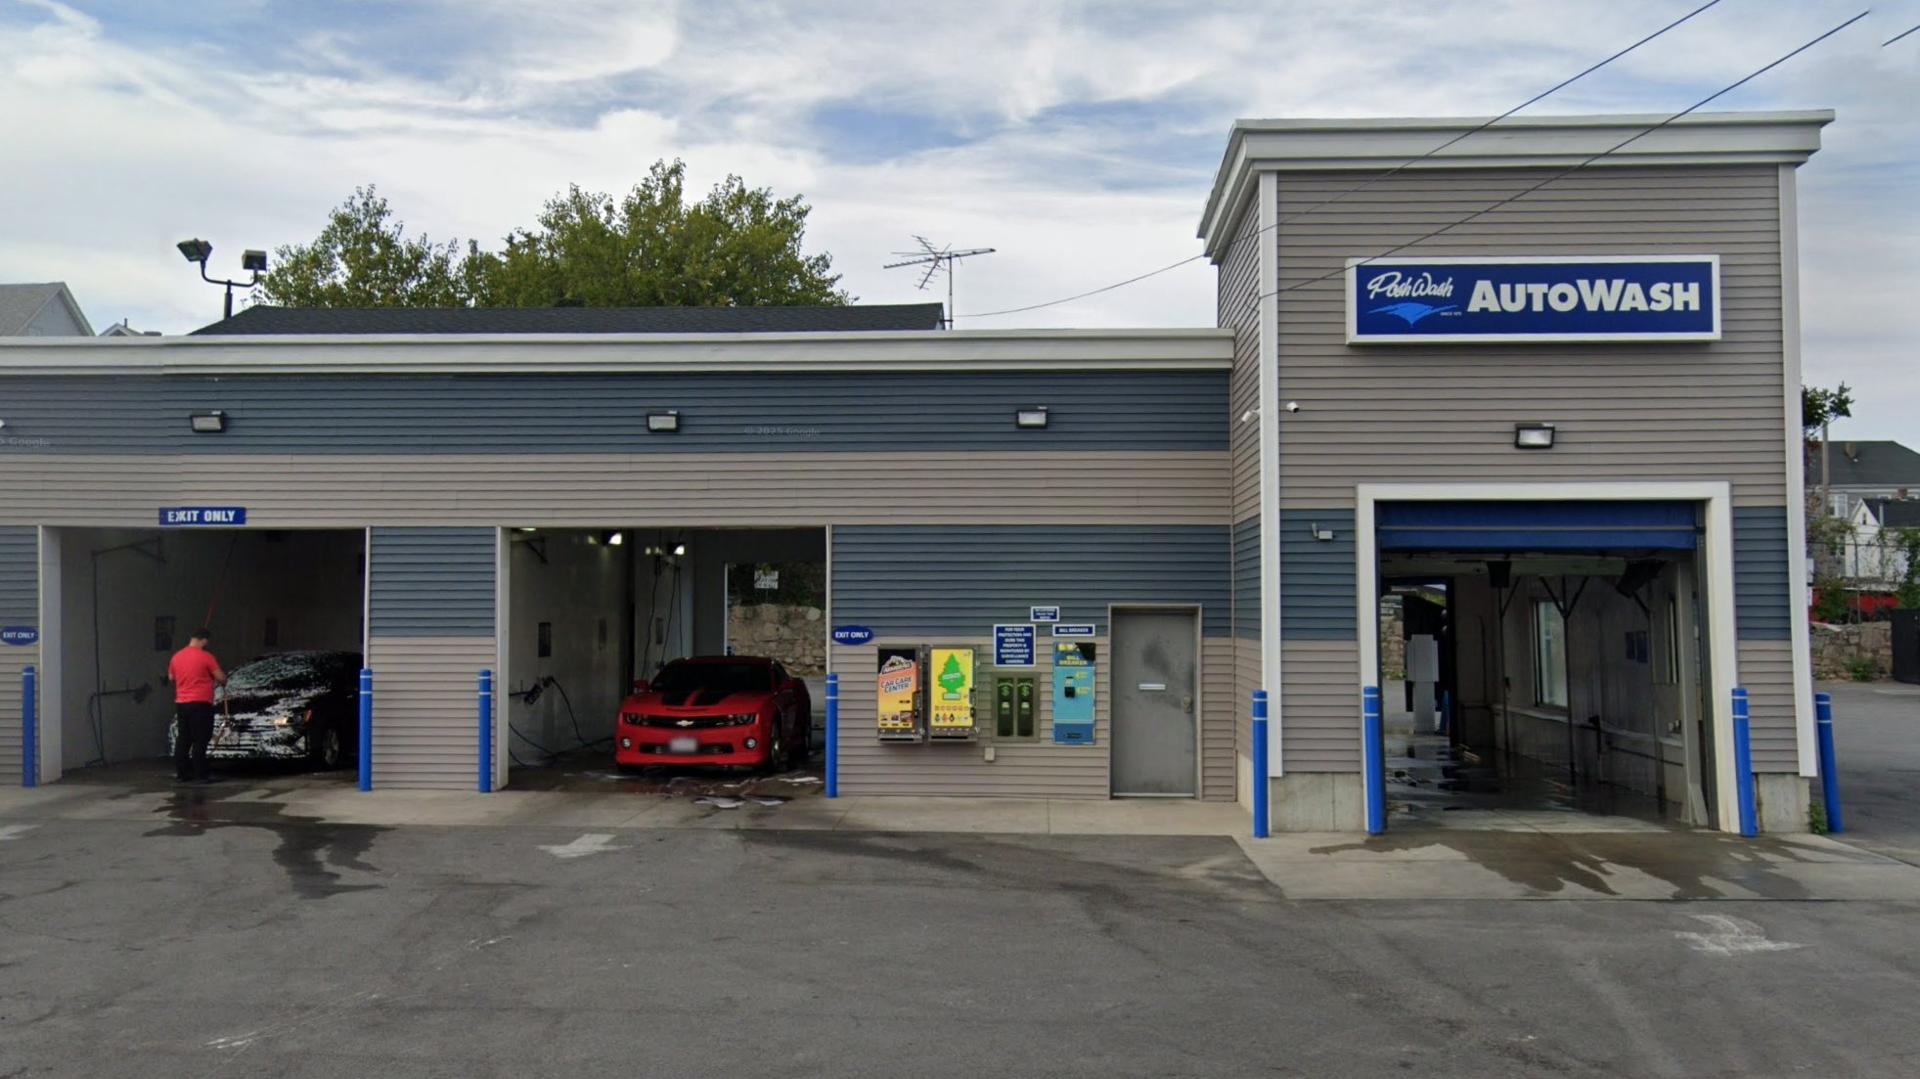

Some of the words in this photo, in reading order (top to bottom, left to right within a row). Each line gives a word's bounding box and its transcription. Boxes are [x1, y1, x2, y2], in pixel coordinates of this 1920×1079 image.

[1367, 271, 1412, 299] Posh
[1412, 272, 1454, 297] Wash
[1467, 279, 1700, 312] AUTOWASH
[204, 511, 235, 522] ONLY
[881, 679, 894, 688] CAR
